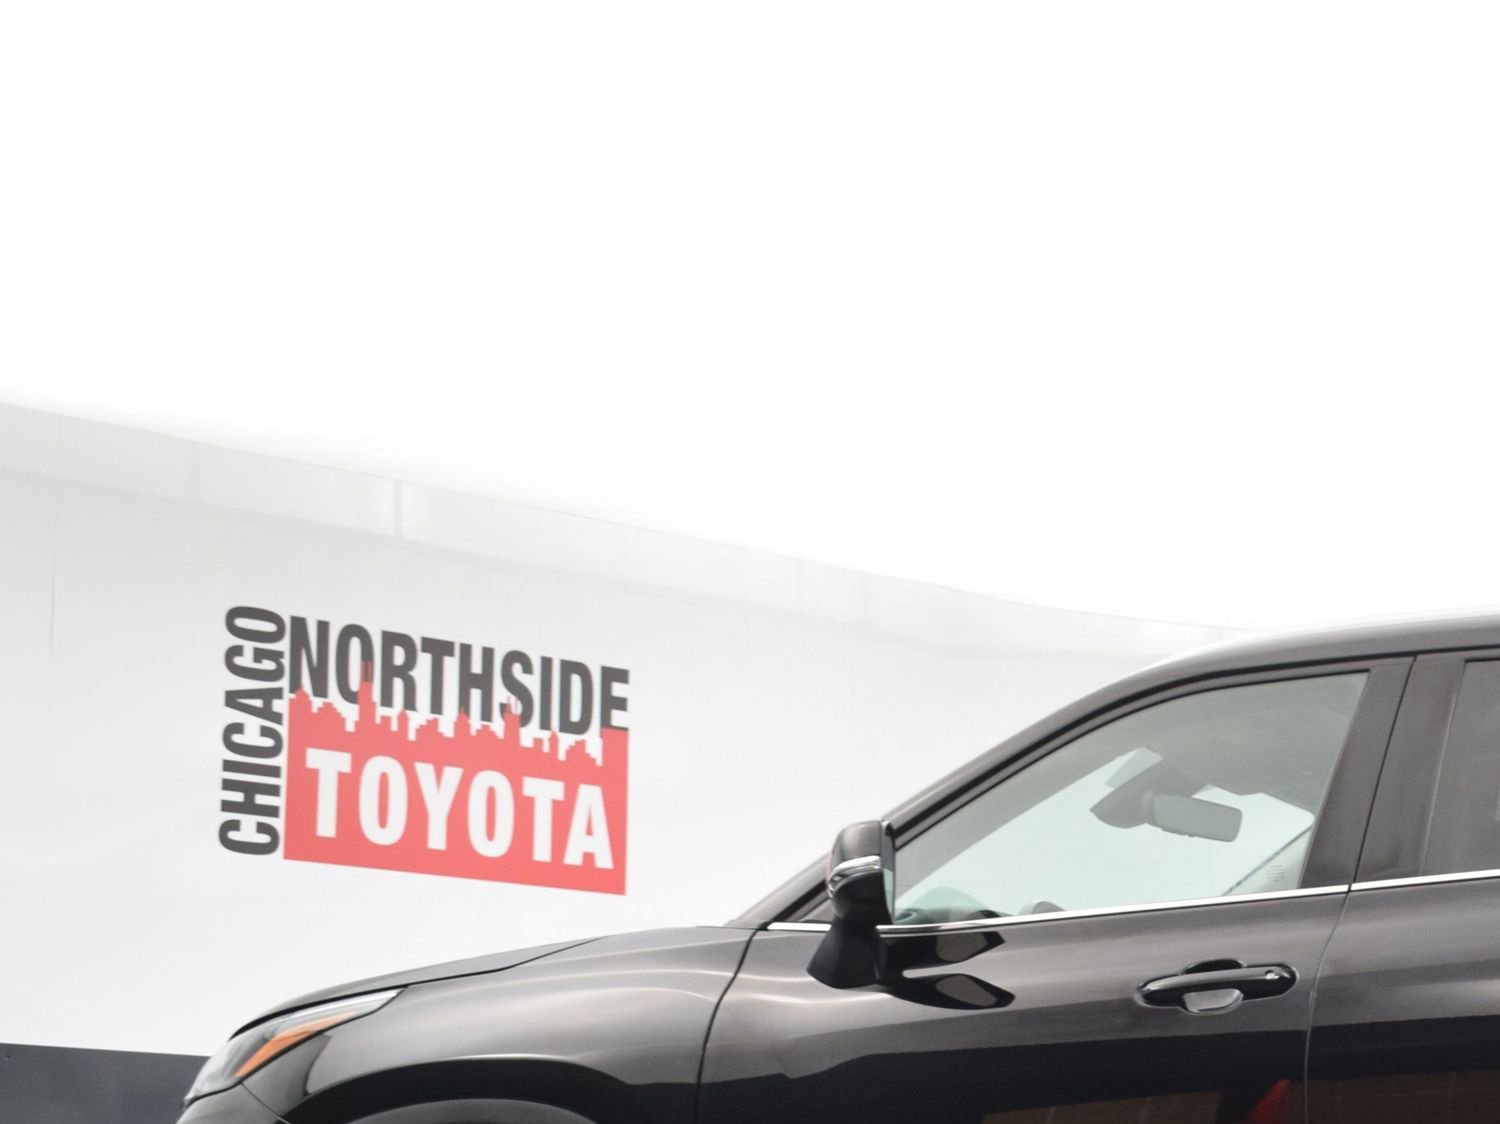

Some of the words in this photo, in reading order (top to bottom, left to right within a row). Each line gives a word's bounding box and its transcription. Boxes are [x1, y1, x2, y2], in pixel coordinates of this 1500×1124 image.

[218, 605, 286, 856] CHICAGO
[288, 614, 630, 736] NORTHSIDE
[306, 747, 615, 870] TOYOTA
